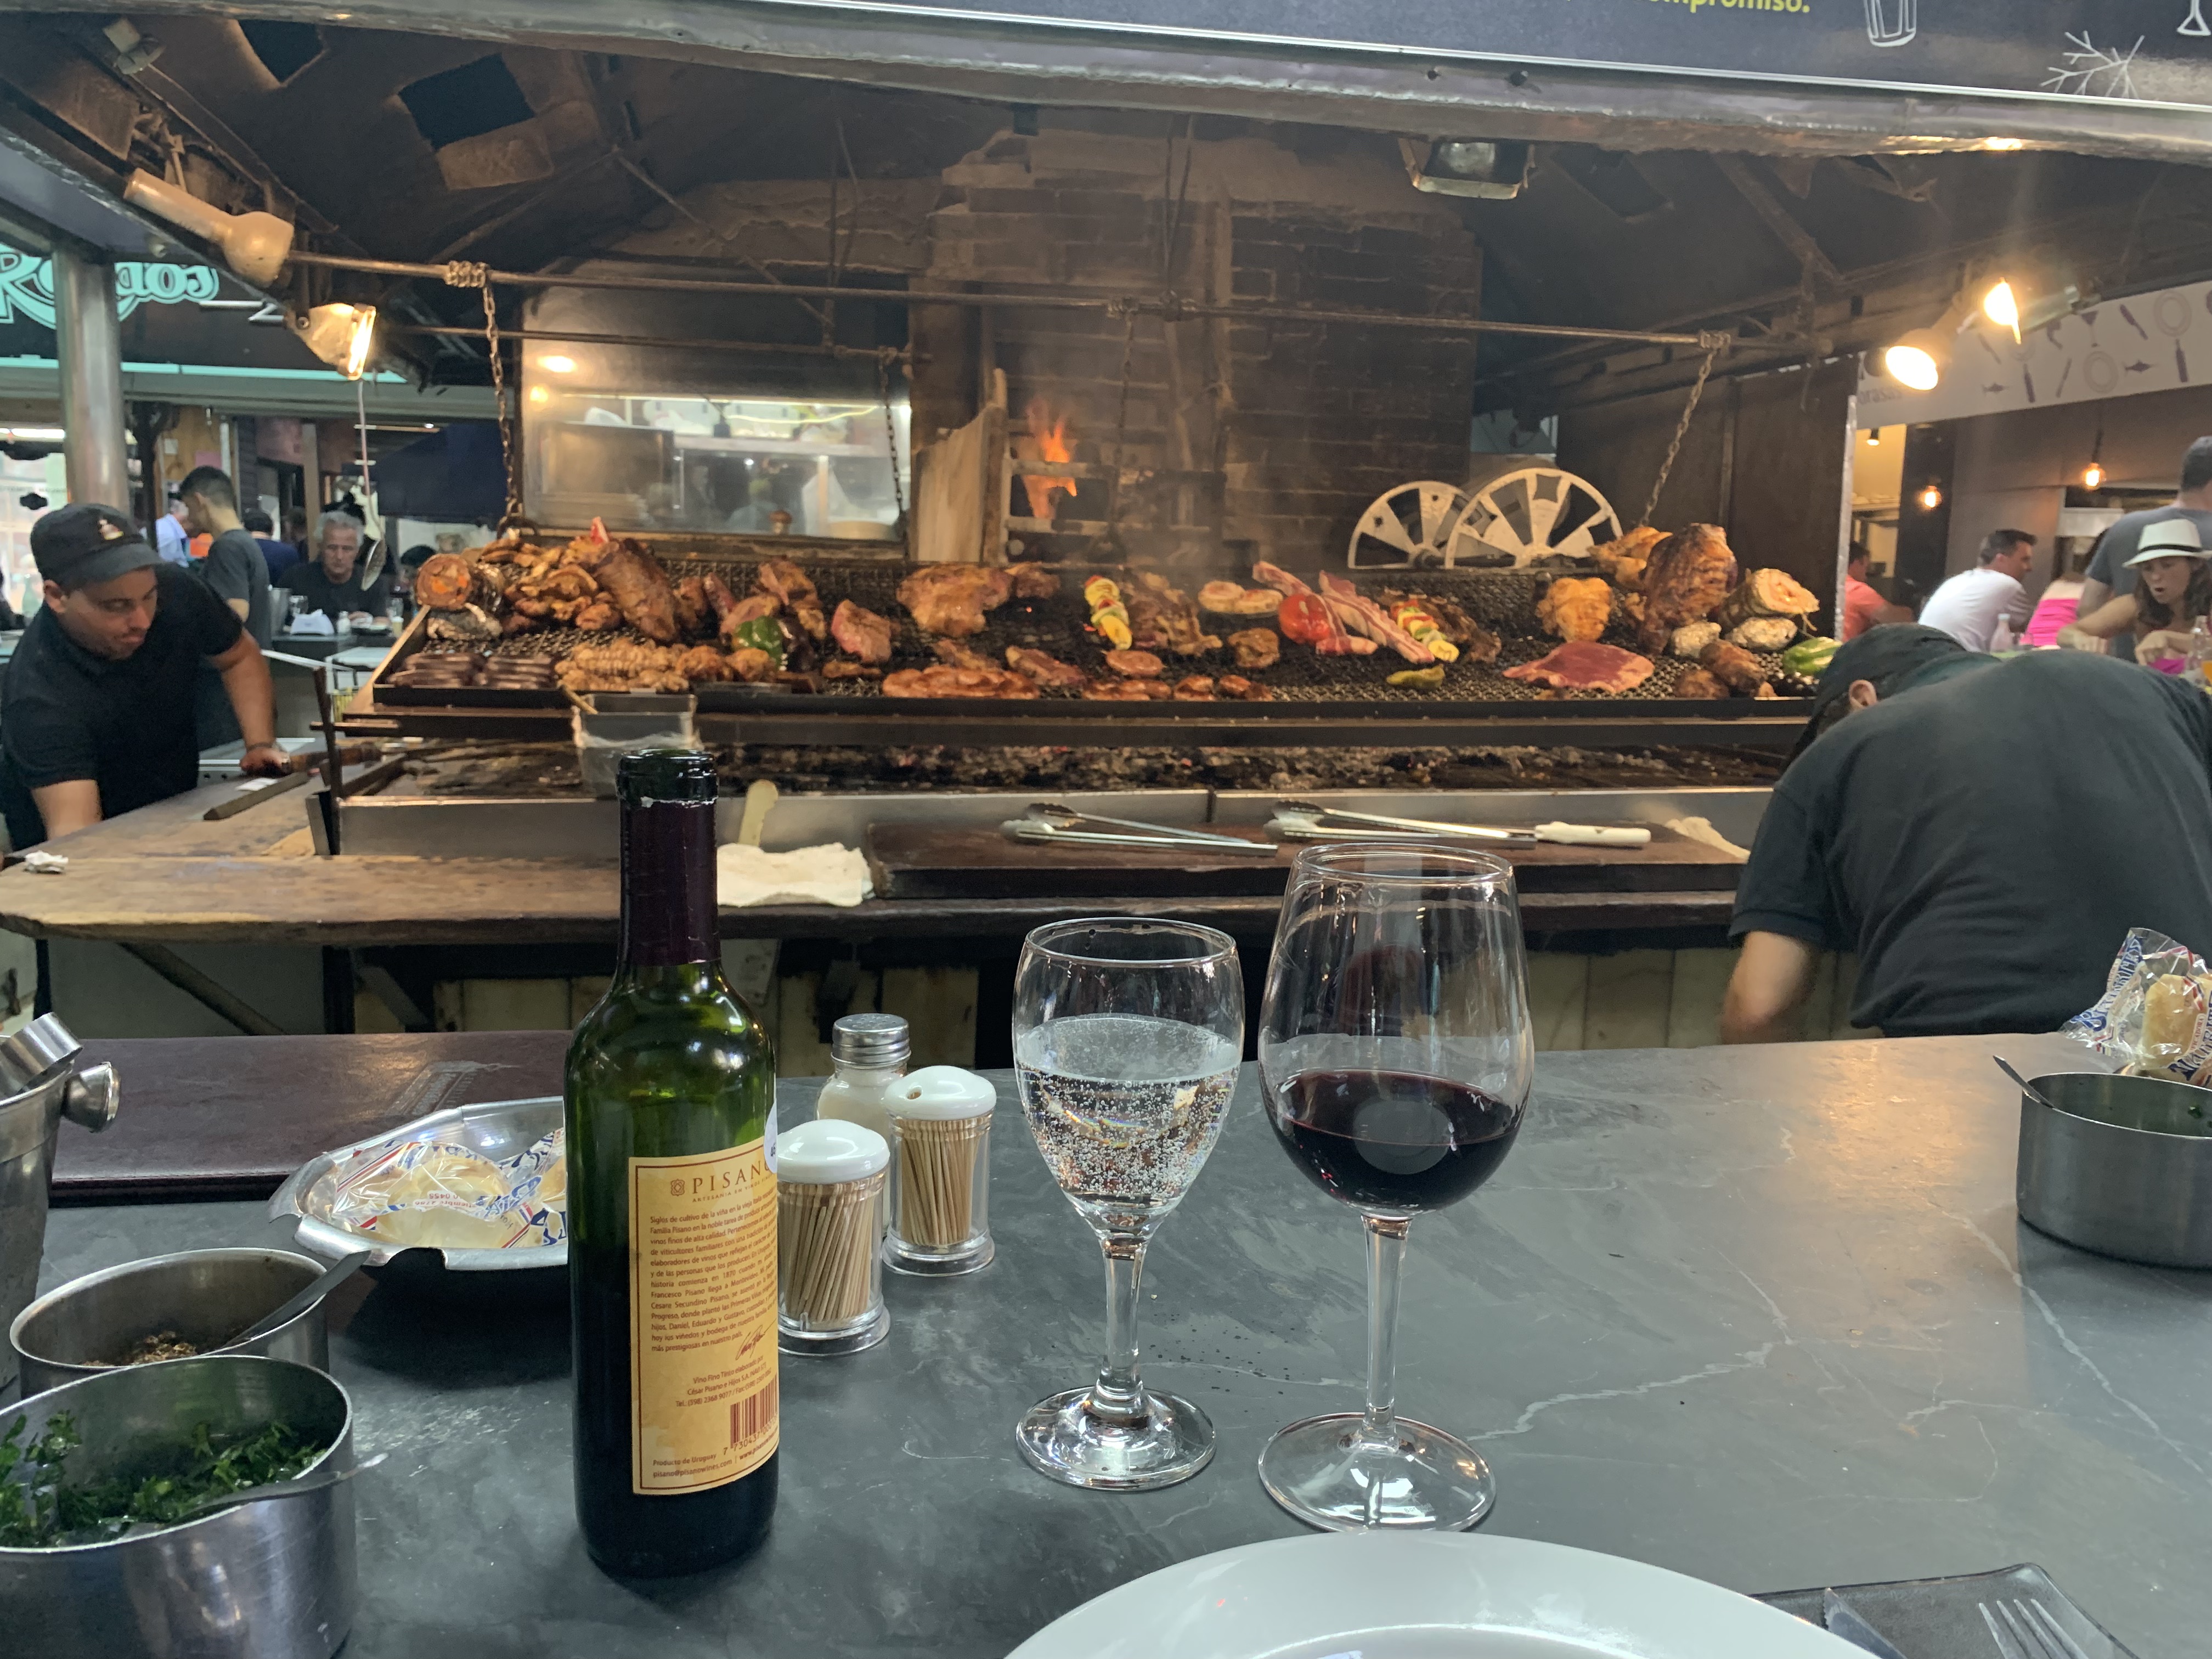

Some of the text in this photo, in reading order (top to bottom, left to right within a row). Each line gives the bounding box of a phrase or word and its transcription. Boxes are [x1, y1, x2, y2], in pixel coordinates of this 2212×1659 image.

[650, 1216, 668, 1225] Siglos
[707, 1221, 723, 1229] noble
[696, 1243, 724, 1252] familiares
[718, 1251, 729, 1260] que
[676, 1268, 703, 1277] personas
[678, 1278, 708, 1286] comienza
[723, 1269, 736, 1278] 1870
[708, 1285, 722, 1293] llega
[675, 1299, 707, 1308] Secundino
[651, 1313, 679, 1321] Progreso,
[680, 1310, 701, 1318] donde
[702, 1306, 720, 1316] plantó
[692, 1318, 716, 1327] Eduardo
[651, 1334, 663, 1342] hoy
[707, 1326, 728, 1335] bodega
[665, 1343, 701, 1352] prestigiosas
[710, 1335, 731, 1345] nuestro
[728, 1378, 741, 1386] Hijos
[687, 1398, 703, 1407] (598)
[704, 1395, 718, 1403] 2368
[719, 1390, 732, 1400] 9077
[723, 1447, 728, 1455] 7
[733, 1431, 760, 1452] 730437
[691, 1454, 716, 1463] Uruguay
[653, 1460, 732, 1478] pisano@pisanowines.com
